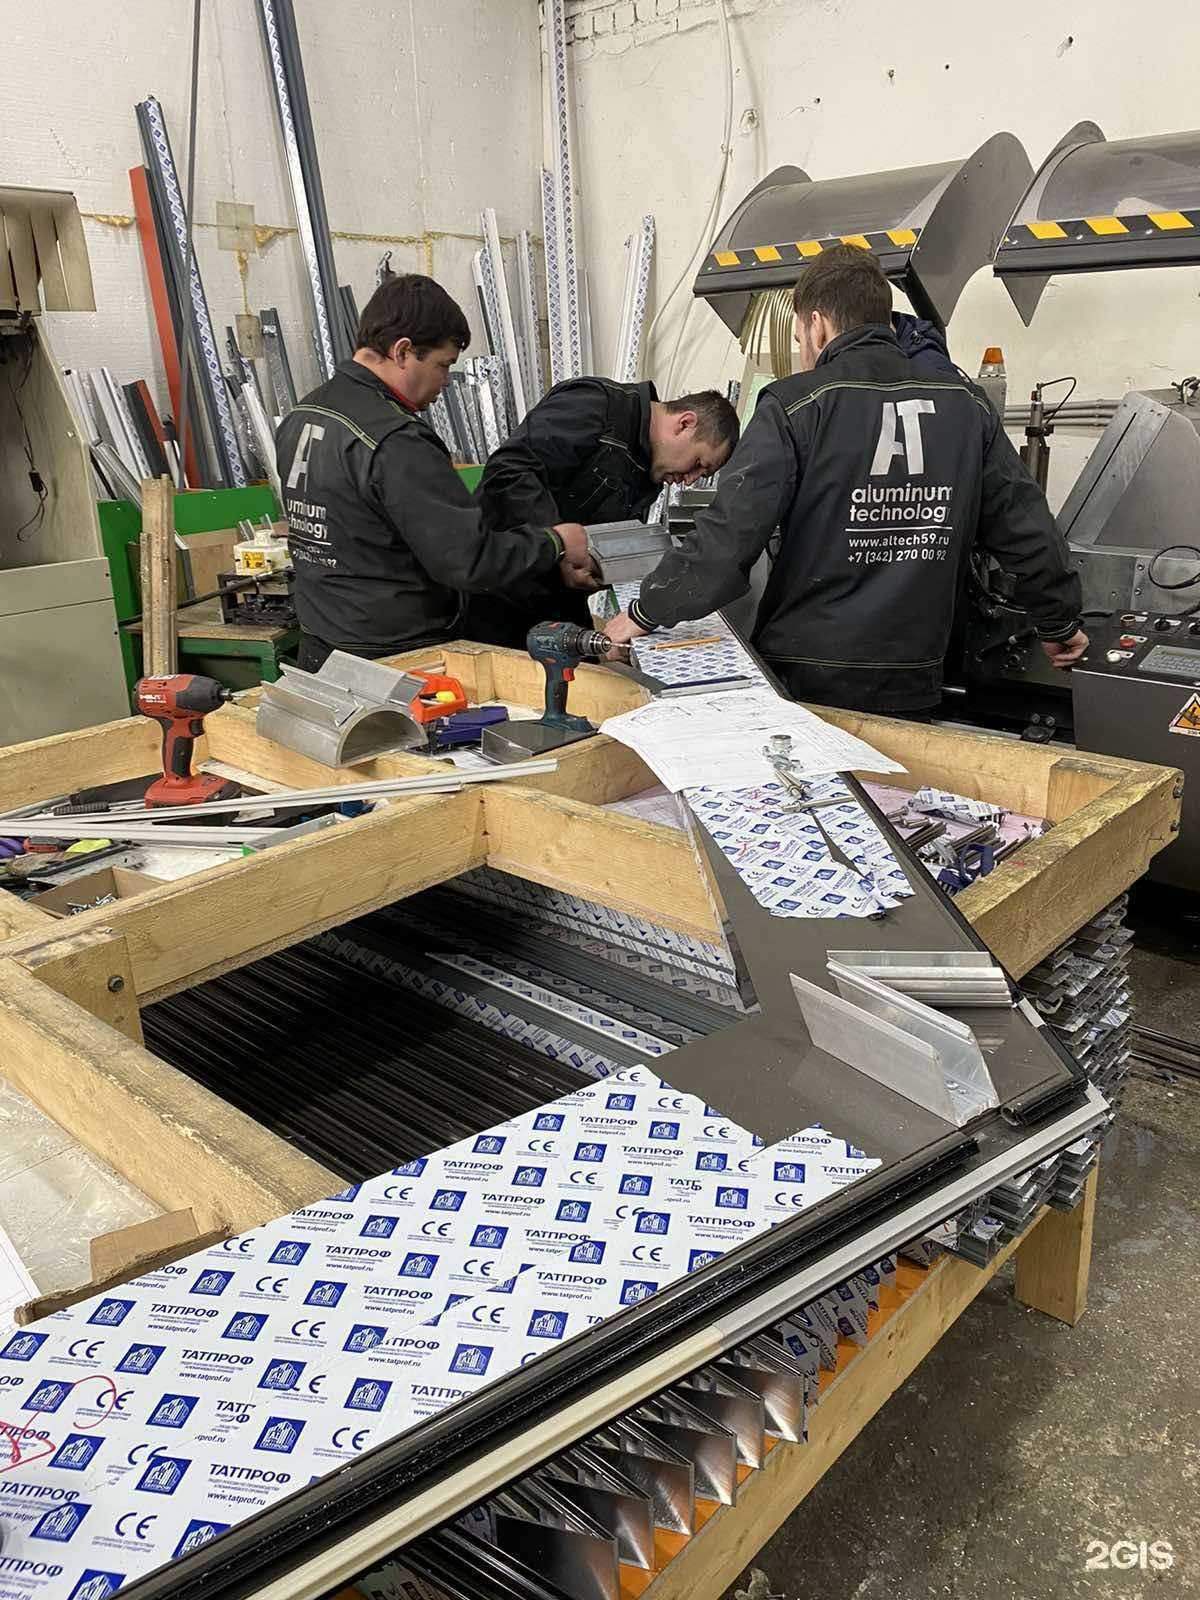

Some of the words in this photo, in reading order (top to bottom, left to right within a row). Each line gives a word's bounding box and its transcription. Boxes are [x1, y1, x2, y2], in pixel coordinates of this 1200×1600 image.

[870, 400, 936, 475] AT
[851, 482, 952, 503] aluminum
[850, 503, 950, 523] technolog
[848, 533, 950, 548] www.altech59.ru
[848, 552, 862, 563] +7
[866, 550, 892, 564] (342)
[896, 549, 918, 561] 270
[922, 549, 934, 560] 00
[936, 550, 946, 560] 92
[579, 1116, 638, 1126] ТАТПРОФ
[622, 1146, 684, 1156] ТАТПРОФ
[442, 1160, 503, 1171] ТАТПРОФ
[482, 1193, 545, 1205] ТАТПРОФ
[687, 1216, 756, 1228] ТАТПРОФ
[524, 1229, 590, 1241] ТАТПРОФ
[326, 1245, 392, 1258] ТАТПРОФ
[537, 1272, 607, 1286] ТАТПРОФ
[362, 1285, 433, 1300] ТАТПРОФ
[150, 1303, 219, 1318] ТАТПРОФ
[182, 1350, 254, 1365] ТАТПРОФ
[209, 1464, 291, 1484] ТАТПРОФ
[0, 1481, 80, 1502] ТАТПРОФ
[207, 1492, 266, 1506] www.tatprof.ru
